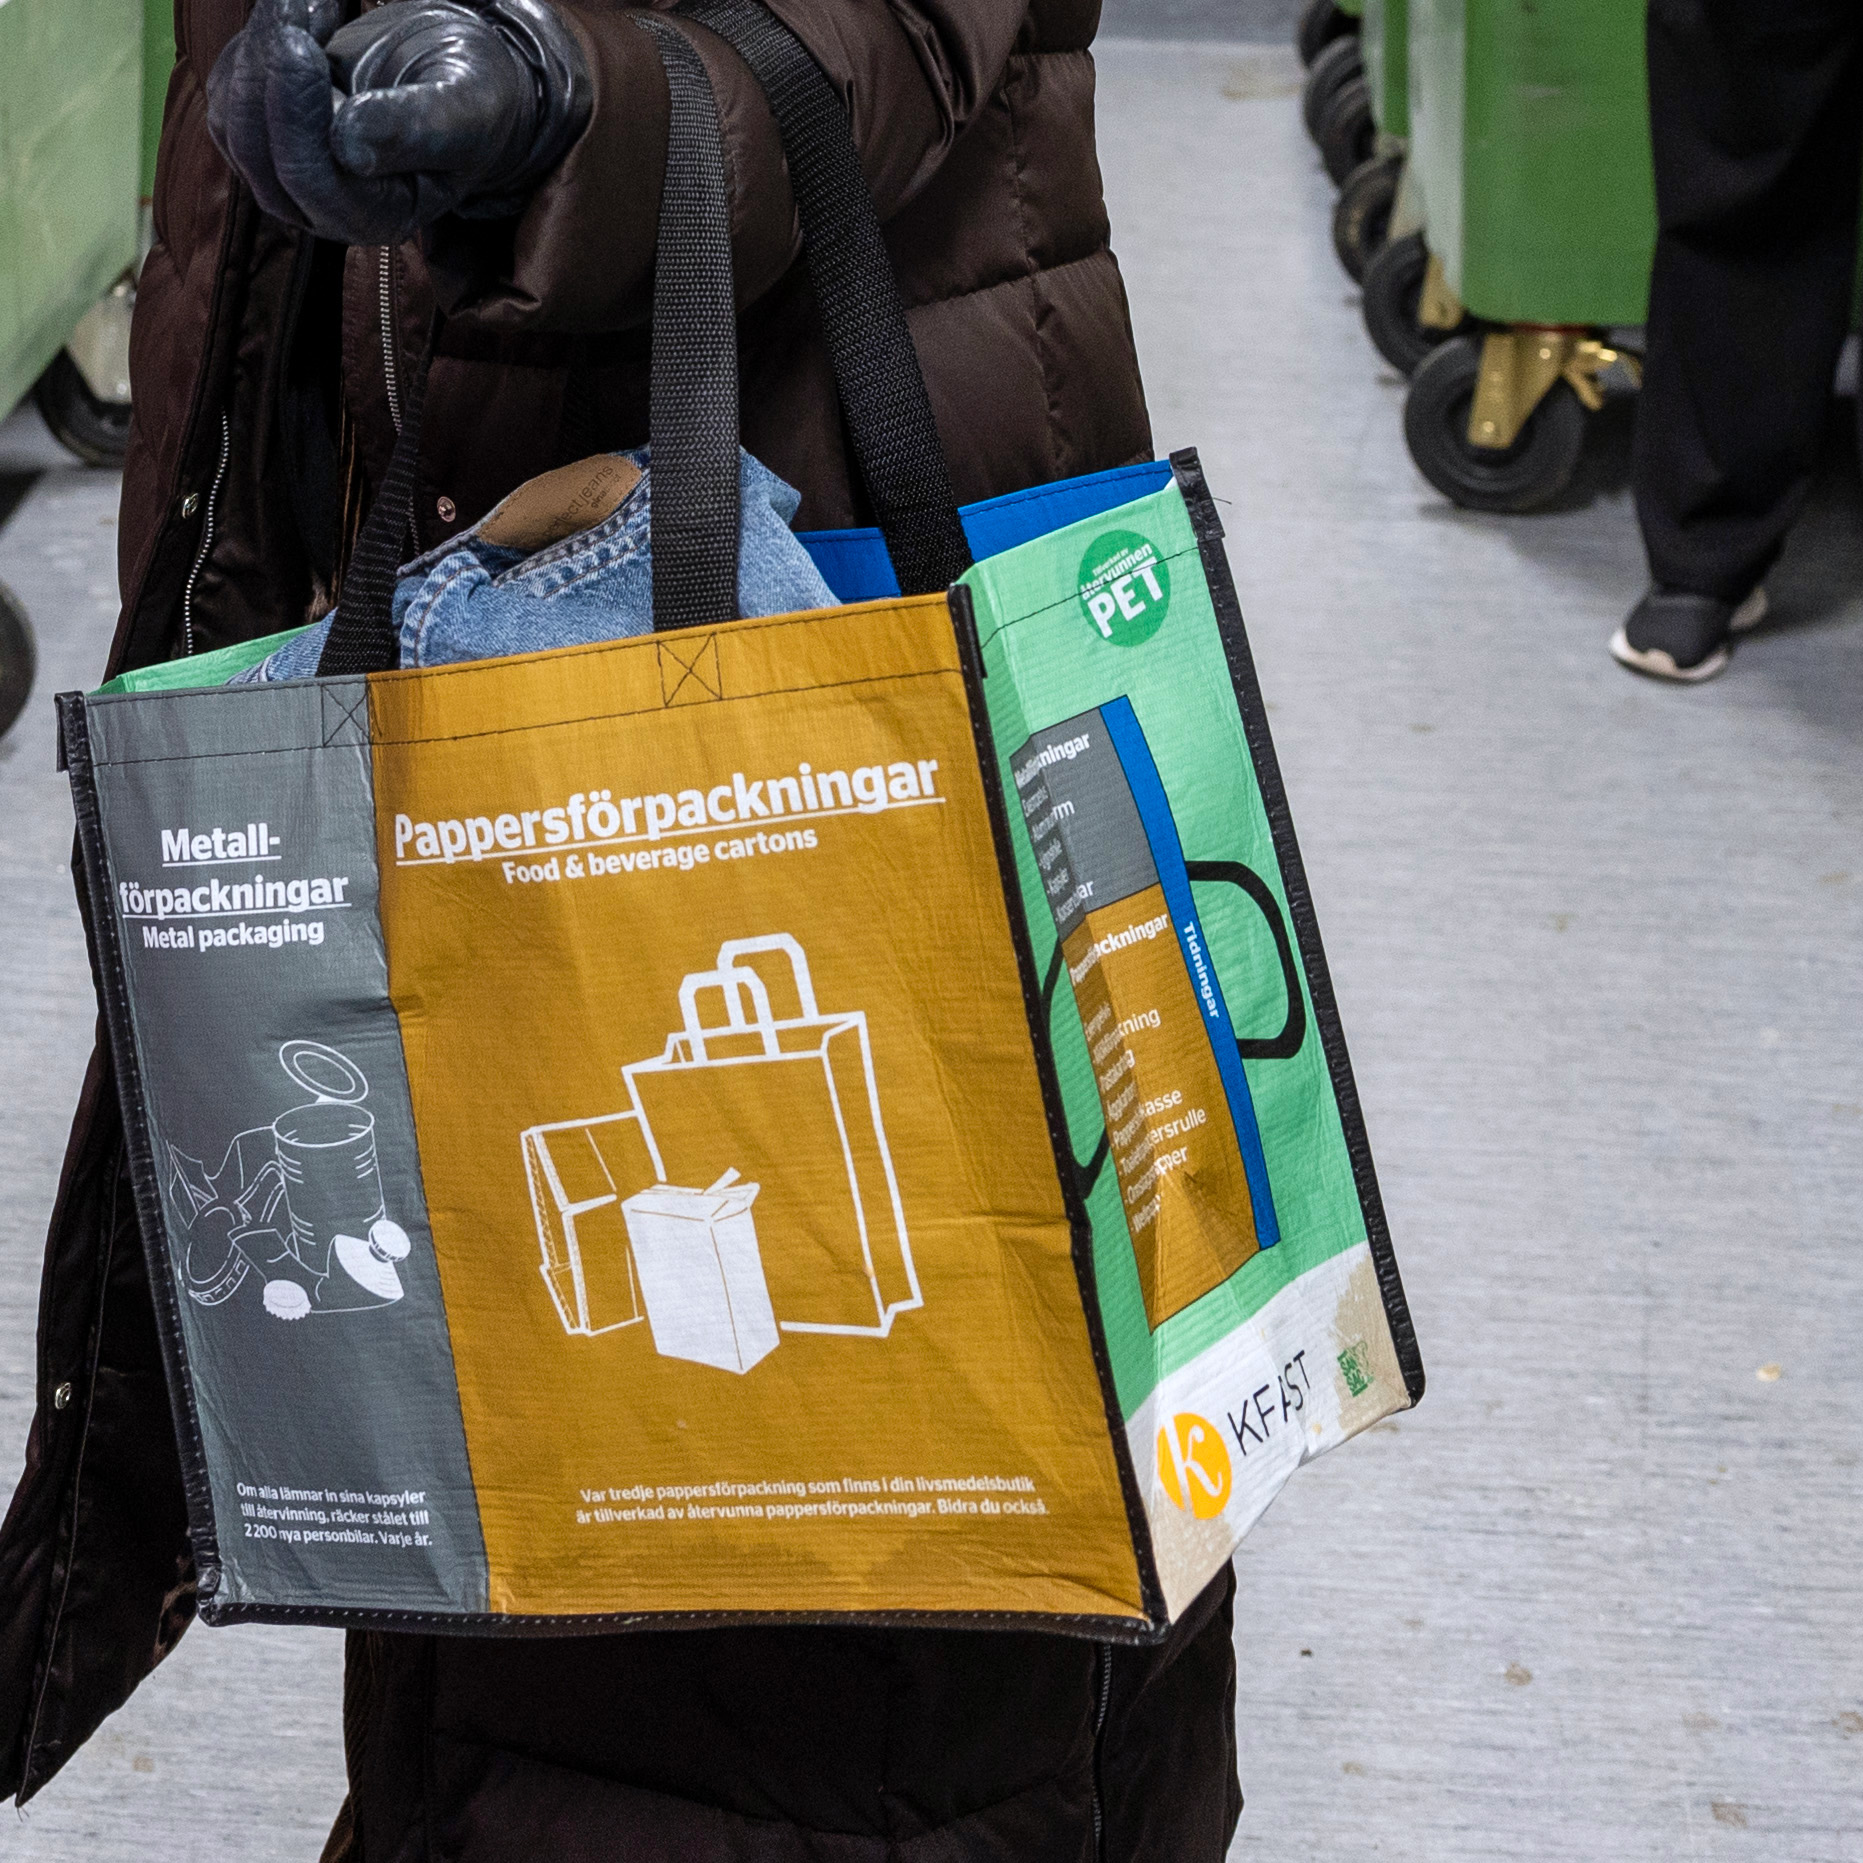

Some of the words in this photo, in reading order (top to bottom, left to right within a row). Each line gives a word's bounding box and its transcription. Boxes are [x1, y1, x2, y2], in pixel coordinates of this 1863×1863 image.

[581, 465, 614, 505] jeans
[1080, 543, 1153, 601] återvunnen
[1087, 556, 1163, 638] PET
[395, 759, 941, 863] Pappersförpackningar
[161, 823, 281, 864] Metall-
[502, 858, 560, 885] Food
[565, 854, 585, 878] &
[589, 839, 711, 877] beverage
[714, 826, 818, 859] cartons
[119, 874, 350, 919] förpackningar
[142, 925, 194, 950] Metal
[199, 918, 324, 952] packaging
[1184, 921, 1219, 1019] Tidningar
[1227, 1350, 1311, 1456] KFAST
[237, 1482, 257, 1497] Om
[258, 1486, 278, 1499] alla
[279, 1487, 323, 1501] lämnar
[325, 1489, 338, 1502] in
[339, 1489, 365, 1503] sina
[366, 1490, 426, 1508] kapsyler
[581, 1488, 606, 1502] Var
[609, 1485, 654, 1503] tredje
[656, 1479, 805, 1500] pappersförpackning
[808, 1481, 840, 1493] som
[843, 1478, 880, 1492] finns
[883, 1478, 888, 1491] i
[890, 1477, 914, 1491] din
[916, 1476, 1035, 1492] livsmedelsbutik
[240, 1503, 255, 1516] till
[257, 1504, 330, 1524] återvinning,
[331, 1510, 370, 1524] räcker
[371, 1511, 408, 1526] stålet
[409, 1510, 429, 1525] till
[576, 1509, 591, 1523] är
[594, 1504, 665, 1522] tillverkad
[666, 1507, 685, 1519] av
[687, 1502, 763, 1518] återvunna
[766, 1499, 935, 1520] pappersförpackningar.
[938, 1498, 977, 1514] Bidra
[979, 1498, 1000, 1514] du
[1002, 1498, 1049, 1515] också.
[279, 1529, 301, 1543] nya
[304, 1529, 378, 1546] personbilar.
[379, 1531, 412, 1548] Varje
[414, 1532, 432, 1546] år.
